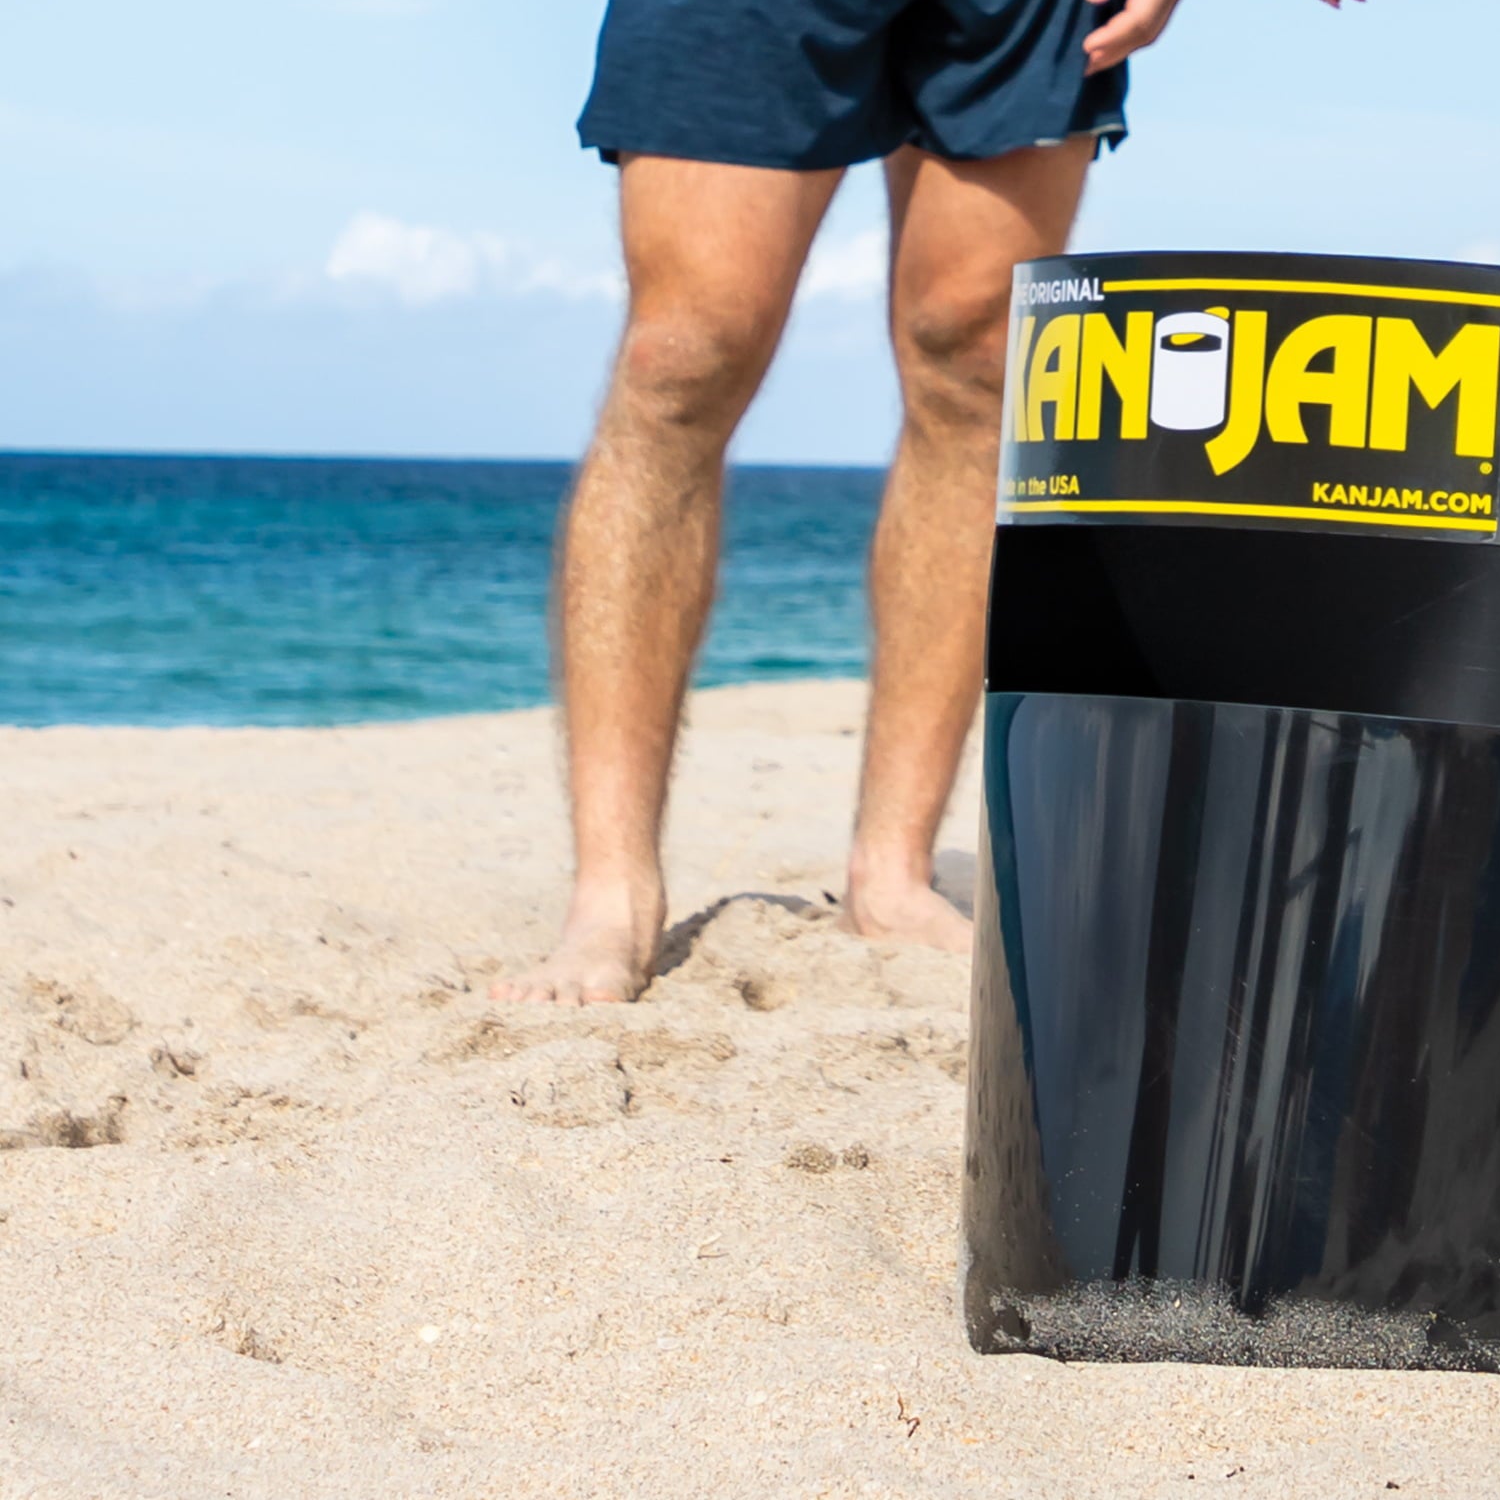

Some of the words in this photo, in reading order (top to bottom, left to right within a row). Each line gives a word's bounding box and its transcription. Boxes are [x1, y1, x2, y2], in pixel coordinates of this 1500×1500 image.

[1028, 277, 1105, 306] ORIGINAL
[1028, 476, 1047, 496] the
[1049, 474, 1080, 496] USA
[1312, 482, 1493, 516] KANJAM.COM
